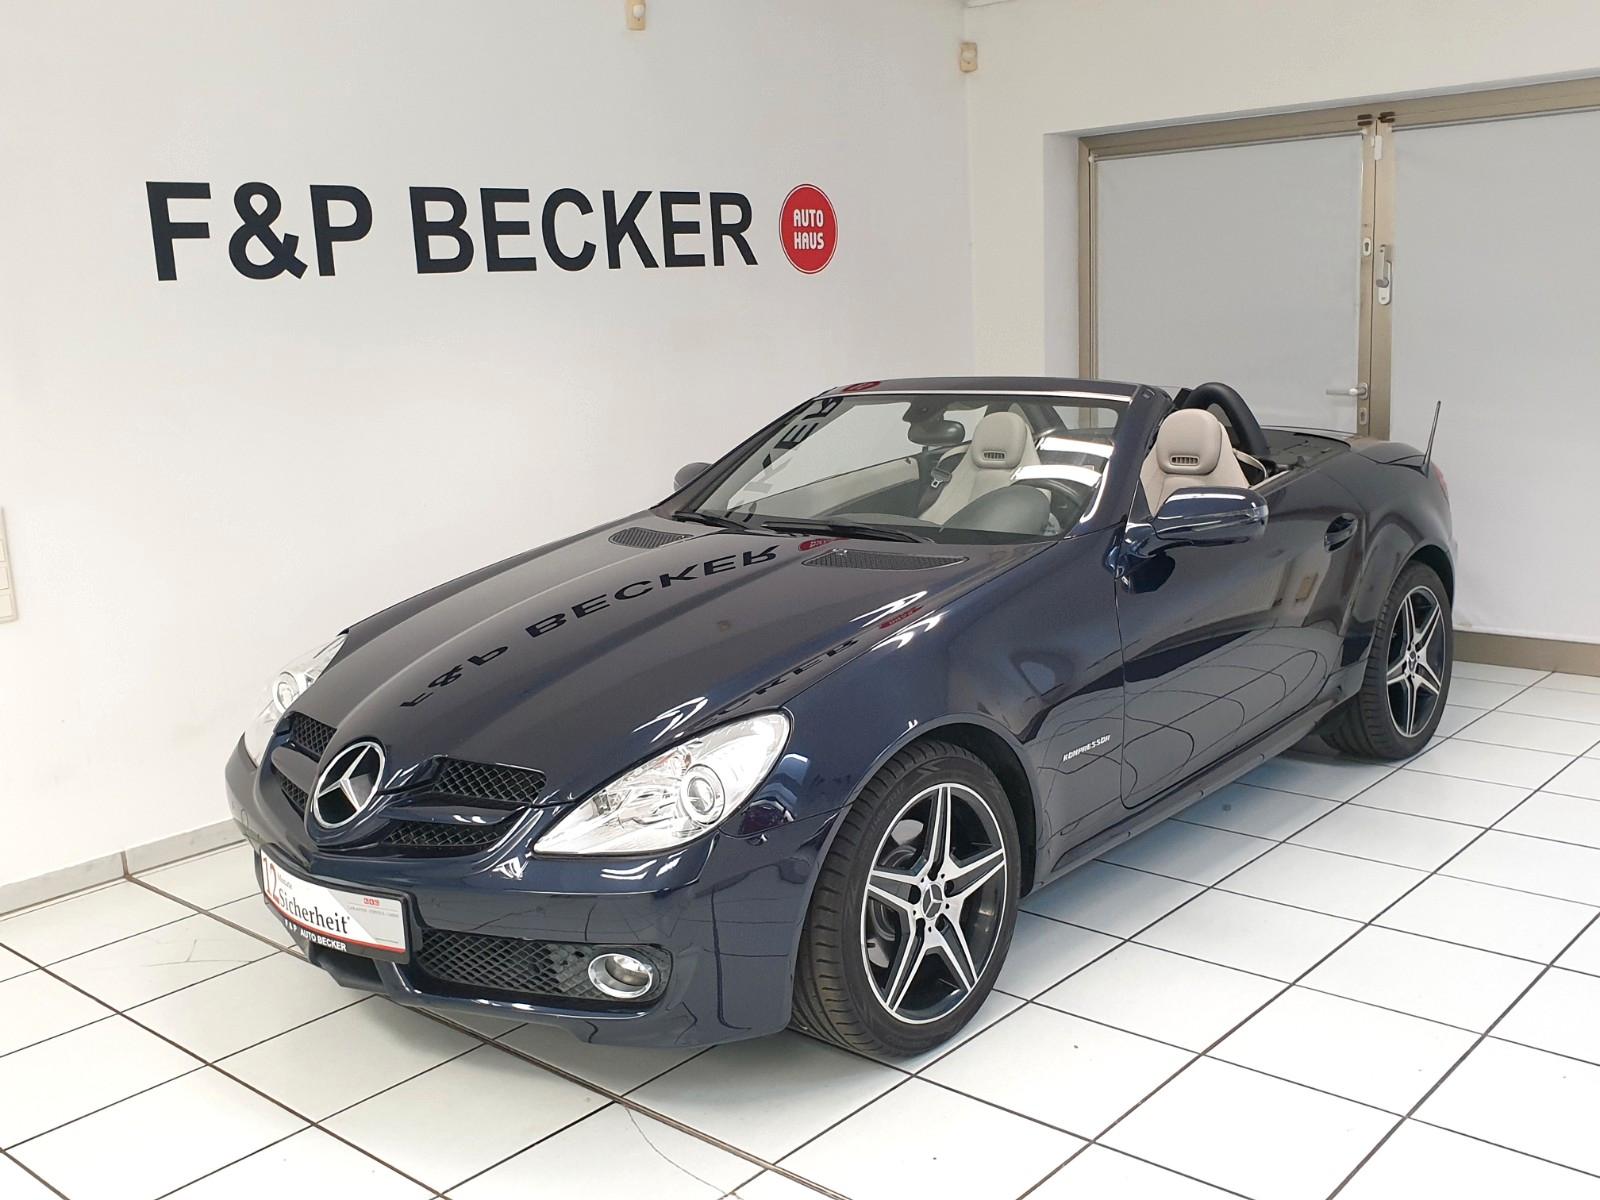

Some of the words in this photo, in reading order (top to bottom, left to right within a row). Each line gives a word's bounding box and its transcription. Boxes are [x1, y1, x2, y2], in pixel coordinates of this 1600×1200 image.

[793, 208, 824, 228] AUTO
[146, 182, 372, 281] F&P
[409, 187, 758, 273] BECKER
[793, 232, 825, 250] HAUS
[279, 888, 349, 934] Sicherheit
[300, 928, 316, 943] AUTO
[317, 936, 347, 952] BECKER
